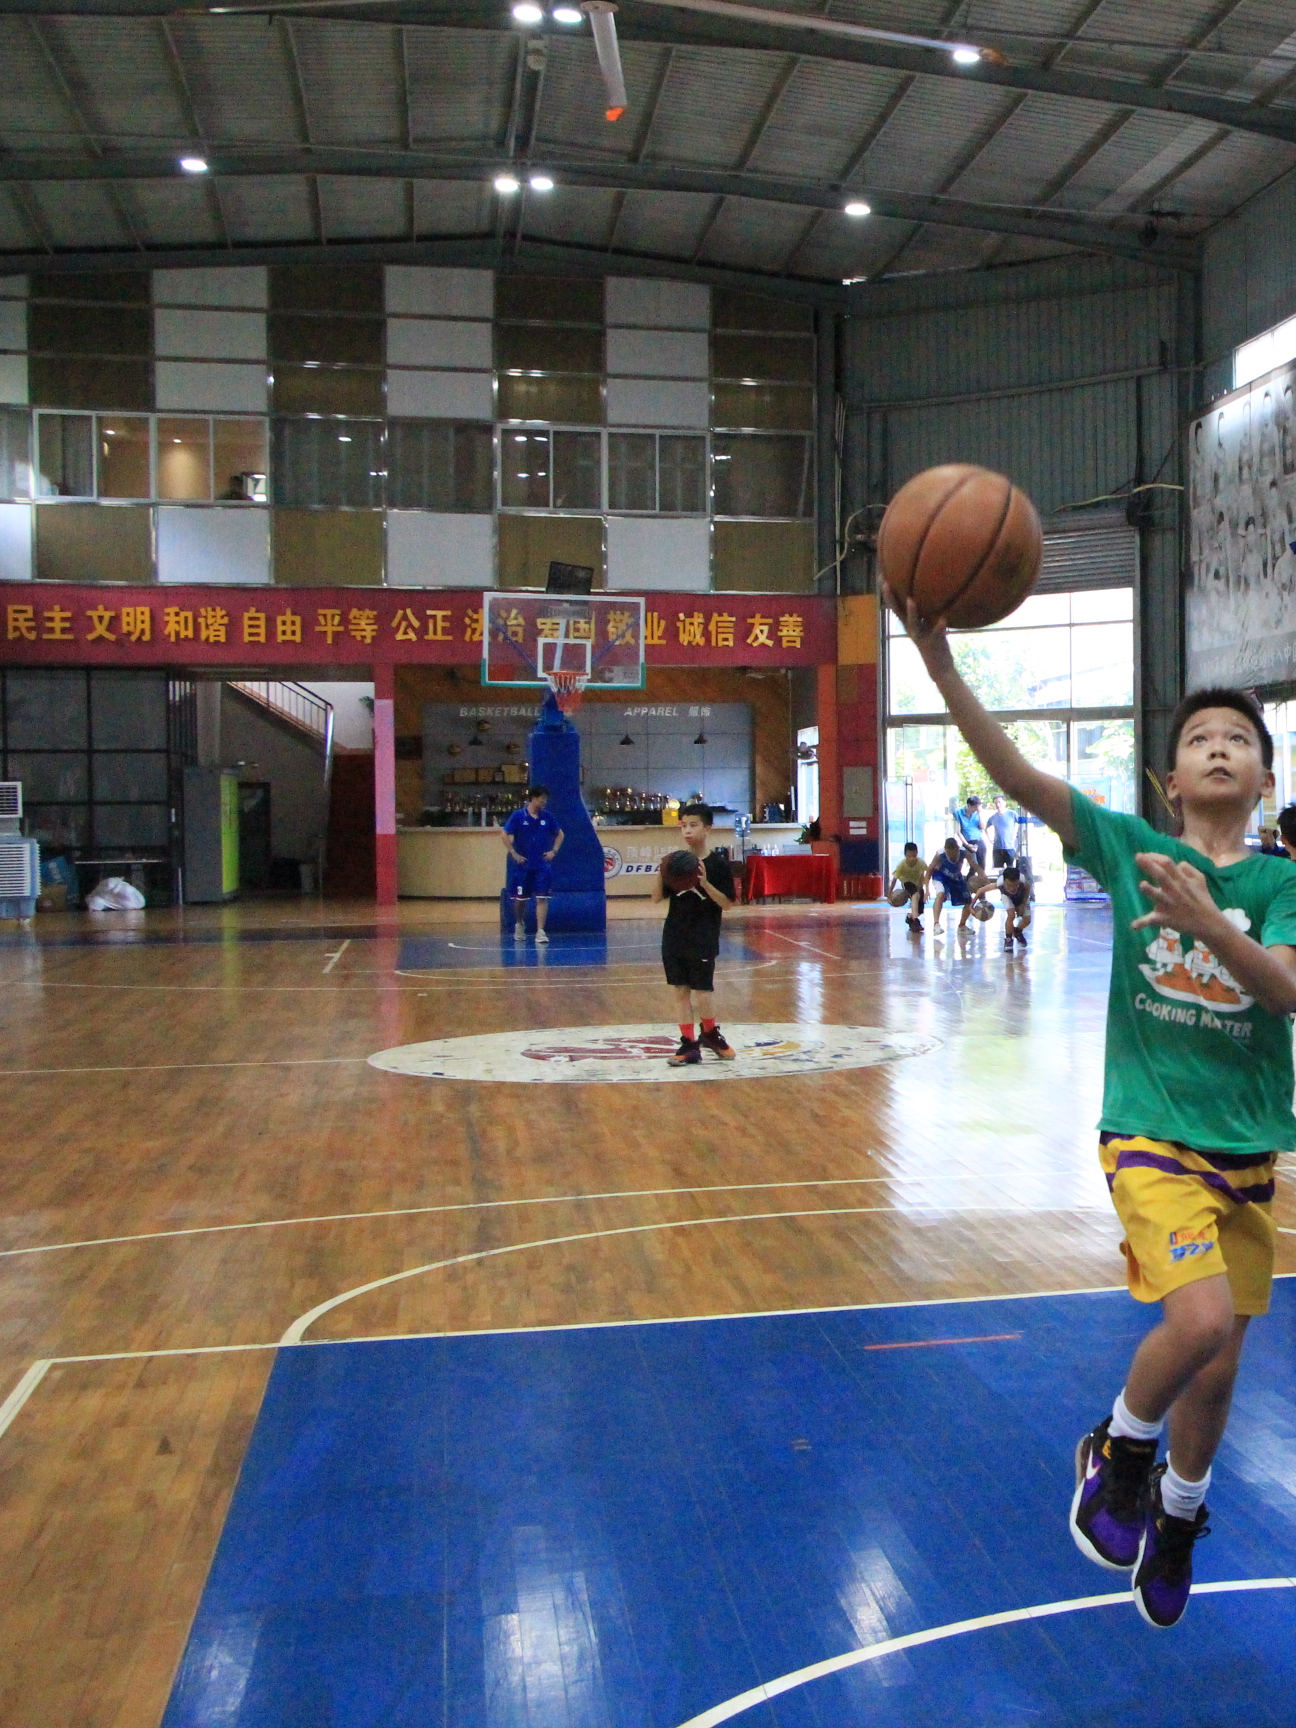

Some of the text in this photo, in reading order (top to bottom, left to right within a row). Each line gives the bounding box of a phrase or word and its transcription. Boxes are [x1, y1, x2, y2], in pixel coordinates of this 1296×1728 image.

[7, 605, 74, 641] 民主
[86, 605, 152, 642] 文明
[164, 606, 229, 643] 和谐
[243, 607, 302, 644] 自由
[314, 608, 378, 644] 平等
[391, 608, 453, 642] 公正
[464, 608, 526, 644] 法治
[607, 609, 667, 646] 敬业
[676, 611, 736, 648] 诚信
[746, 613, 805, 649] 友善
[459, 706, 541, 718] BASKETBALL
[623, 706, 679, 717] APPAREL
[1134, 992, 1197, 1026] COOKING
